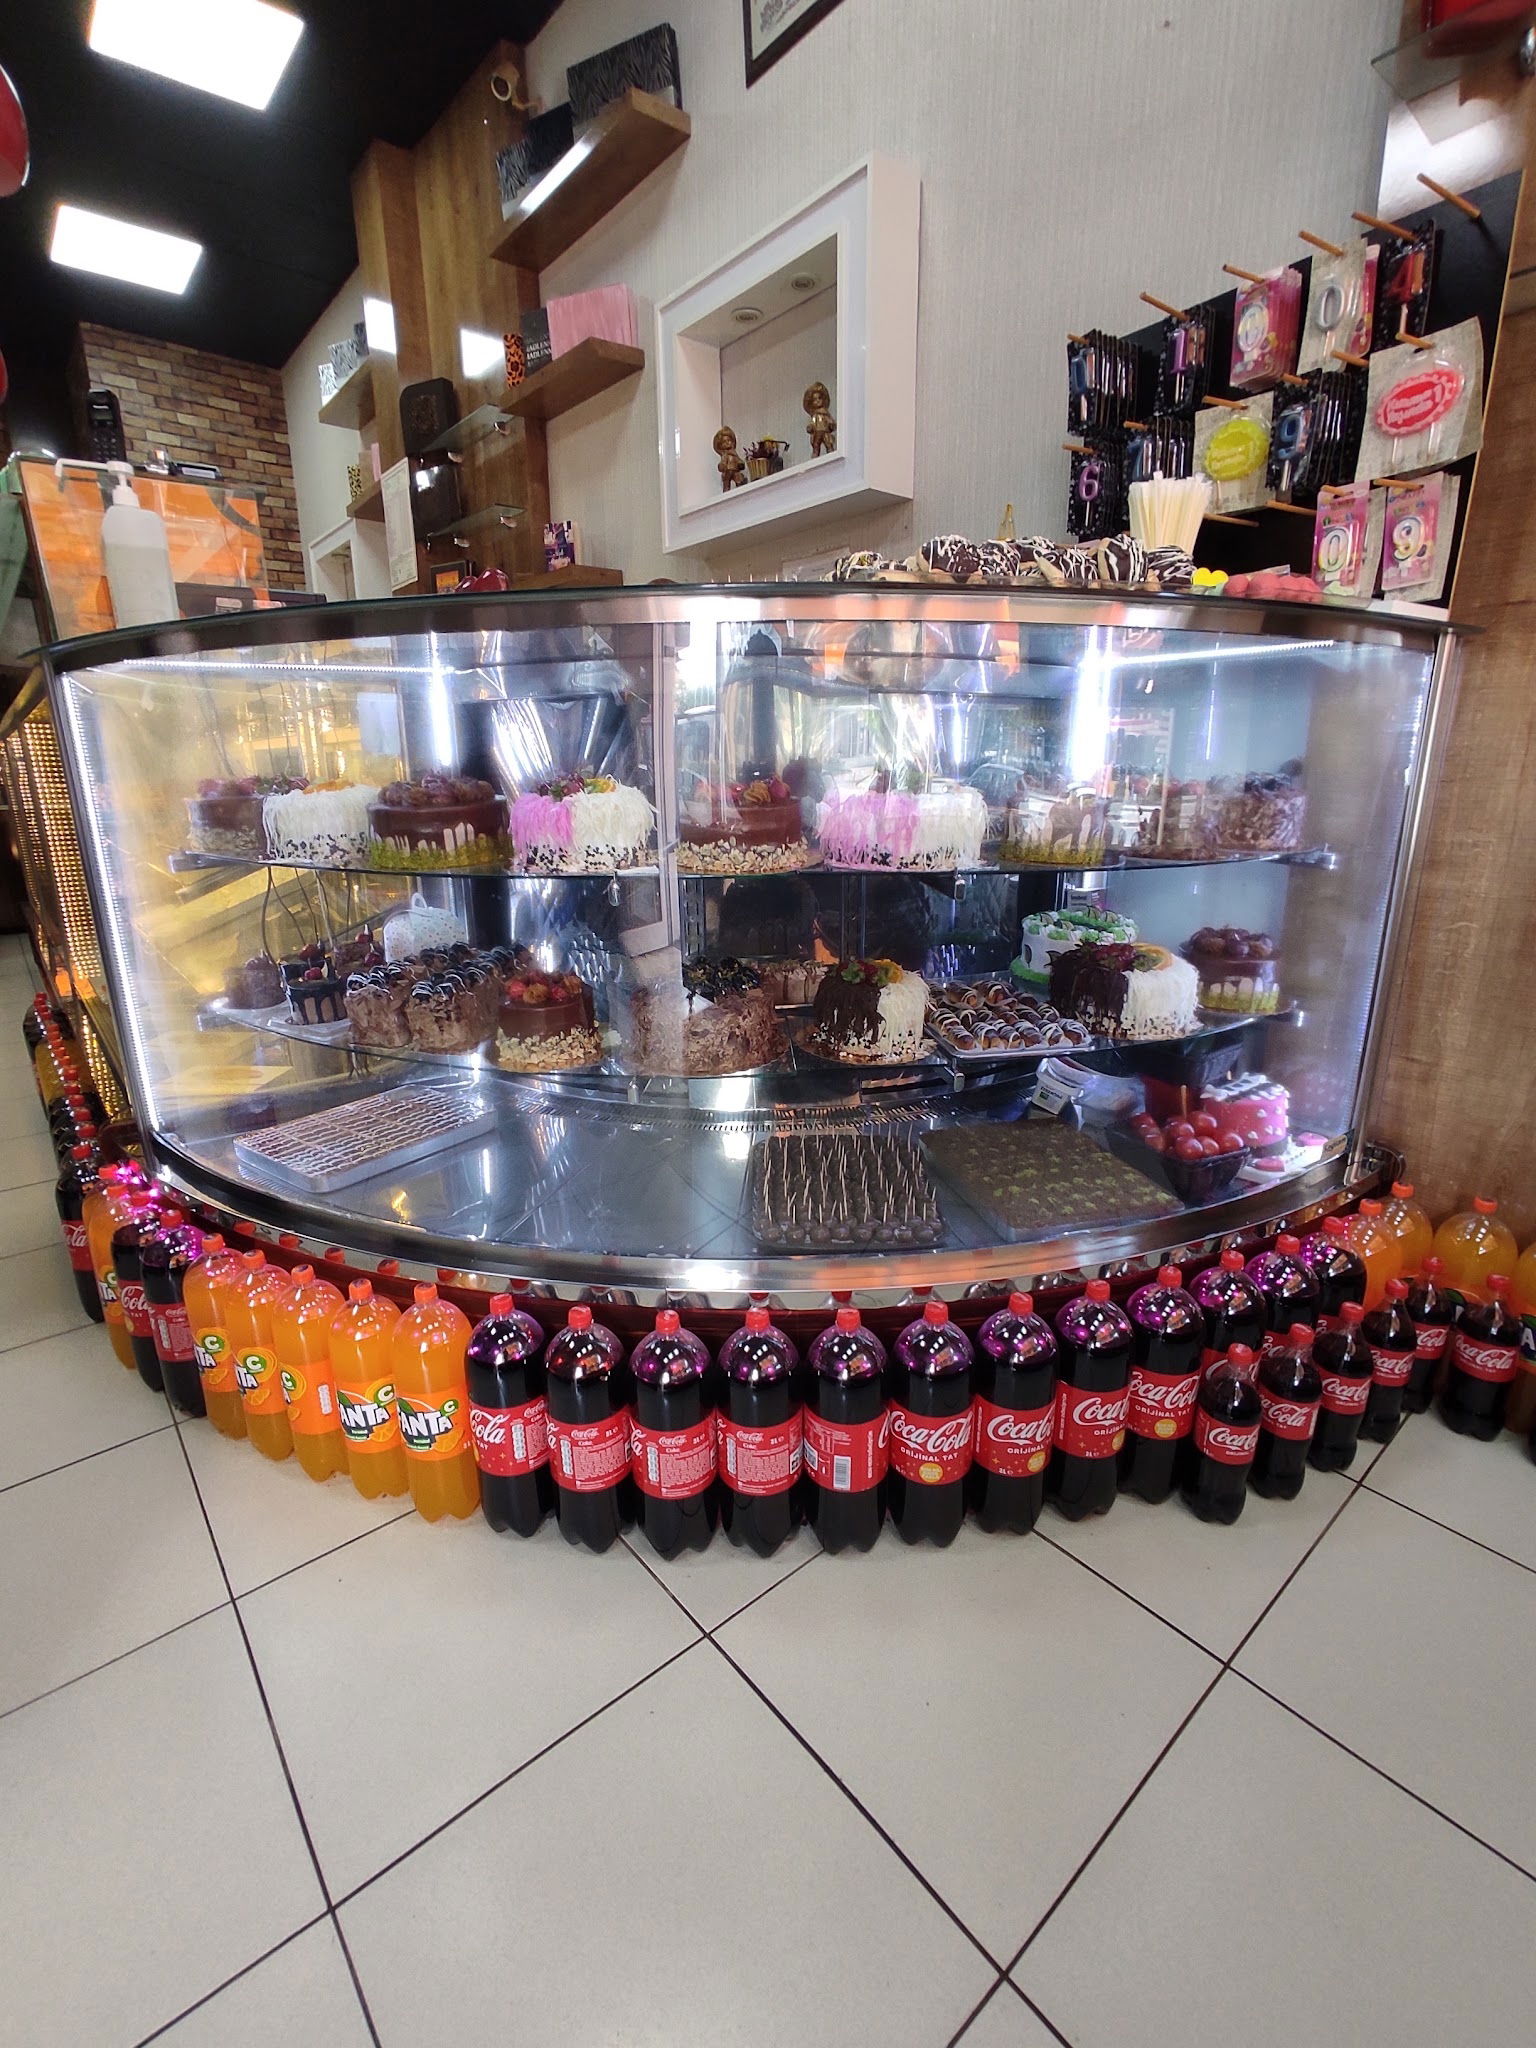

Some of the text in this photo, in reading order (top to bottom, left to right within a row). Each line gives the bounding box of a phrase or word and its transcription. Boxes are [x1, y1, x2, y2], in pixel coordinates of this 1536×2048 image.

[1079, 464, 1100, 501] 6
[1393, 516, 1425, 561] 9
[1319, 526, 1349, 573] 0
[205, 1336, 220, 1350] C
[246, 1356, 262, 1371] C
[444, 1401, 456, 1413] C
[900, 1446, 958, 1462] ORİJİNAL TAT
